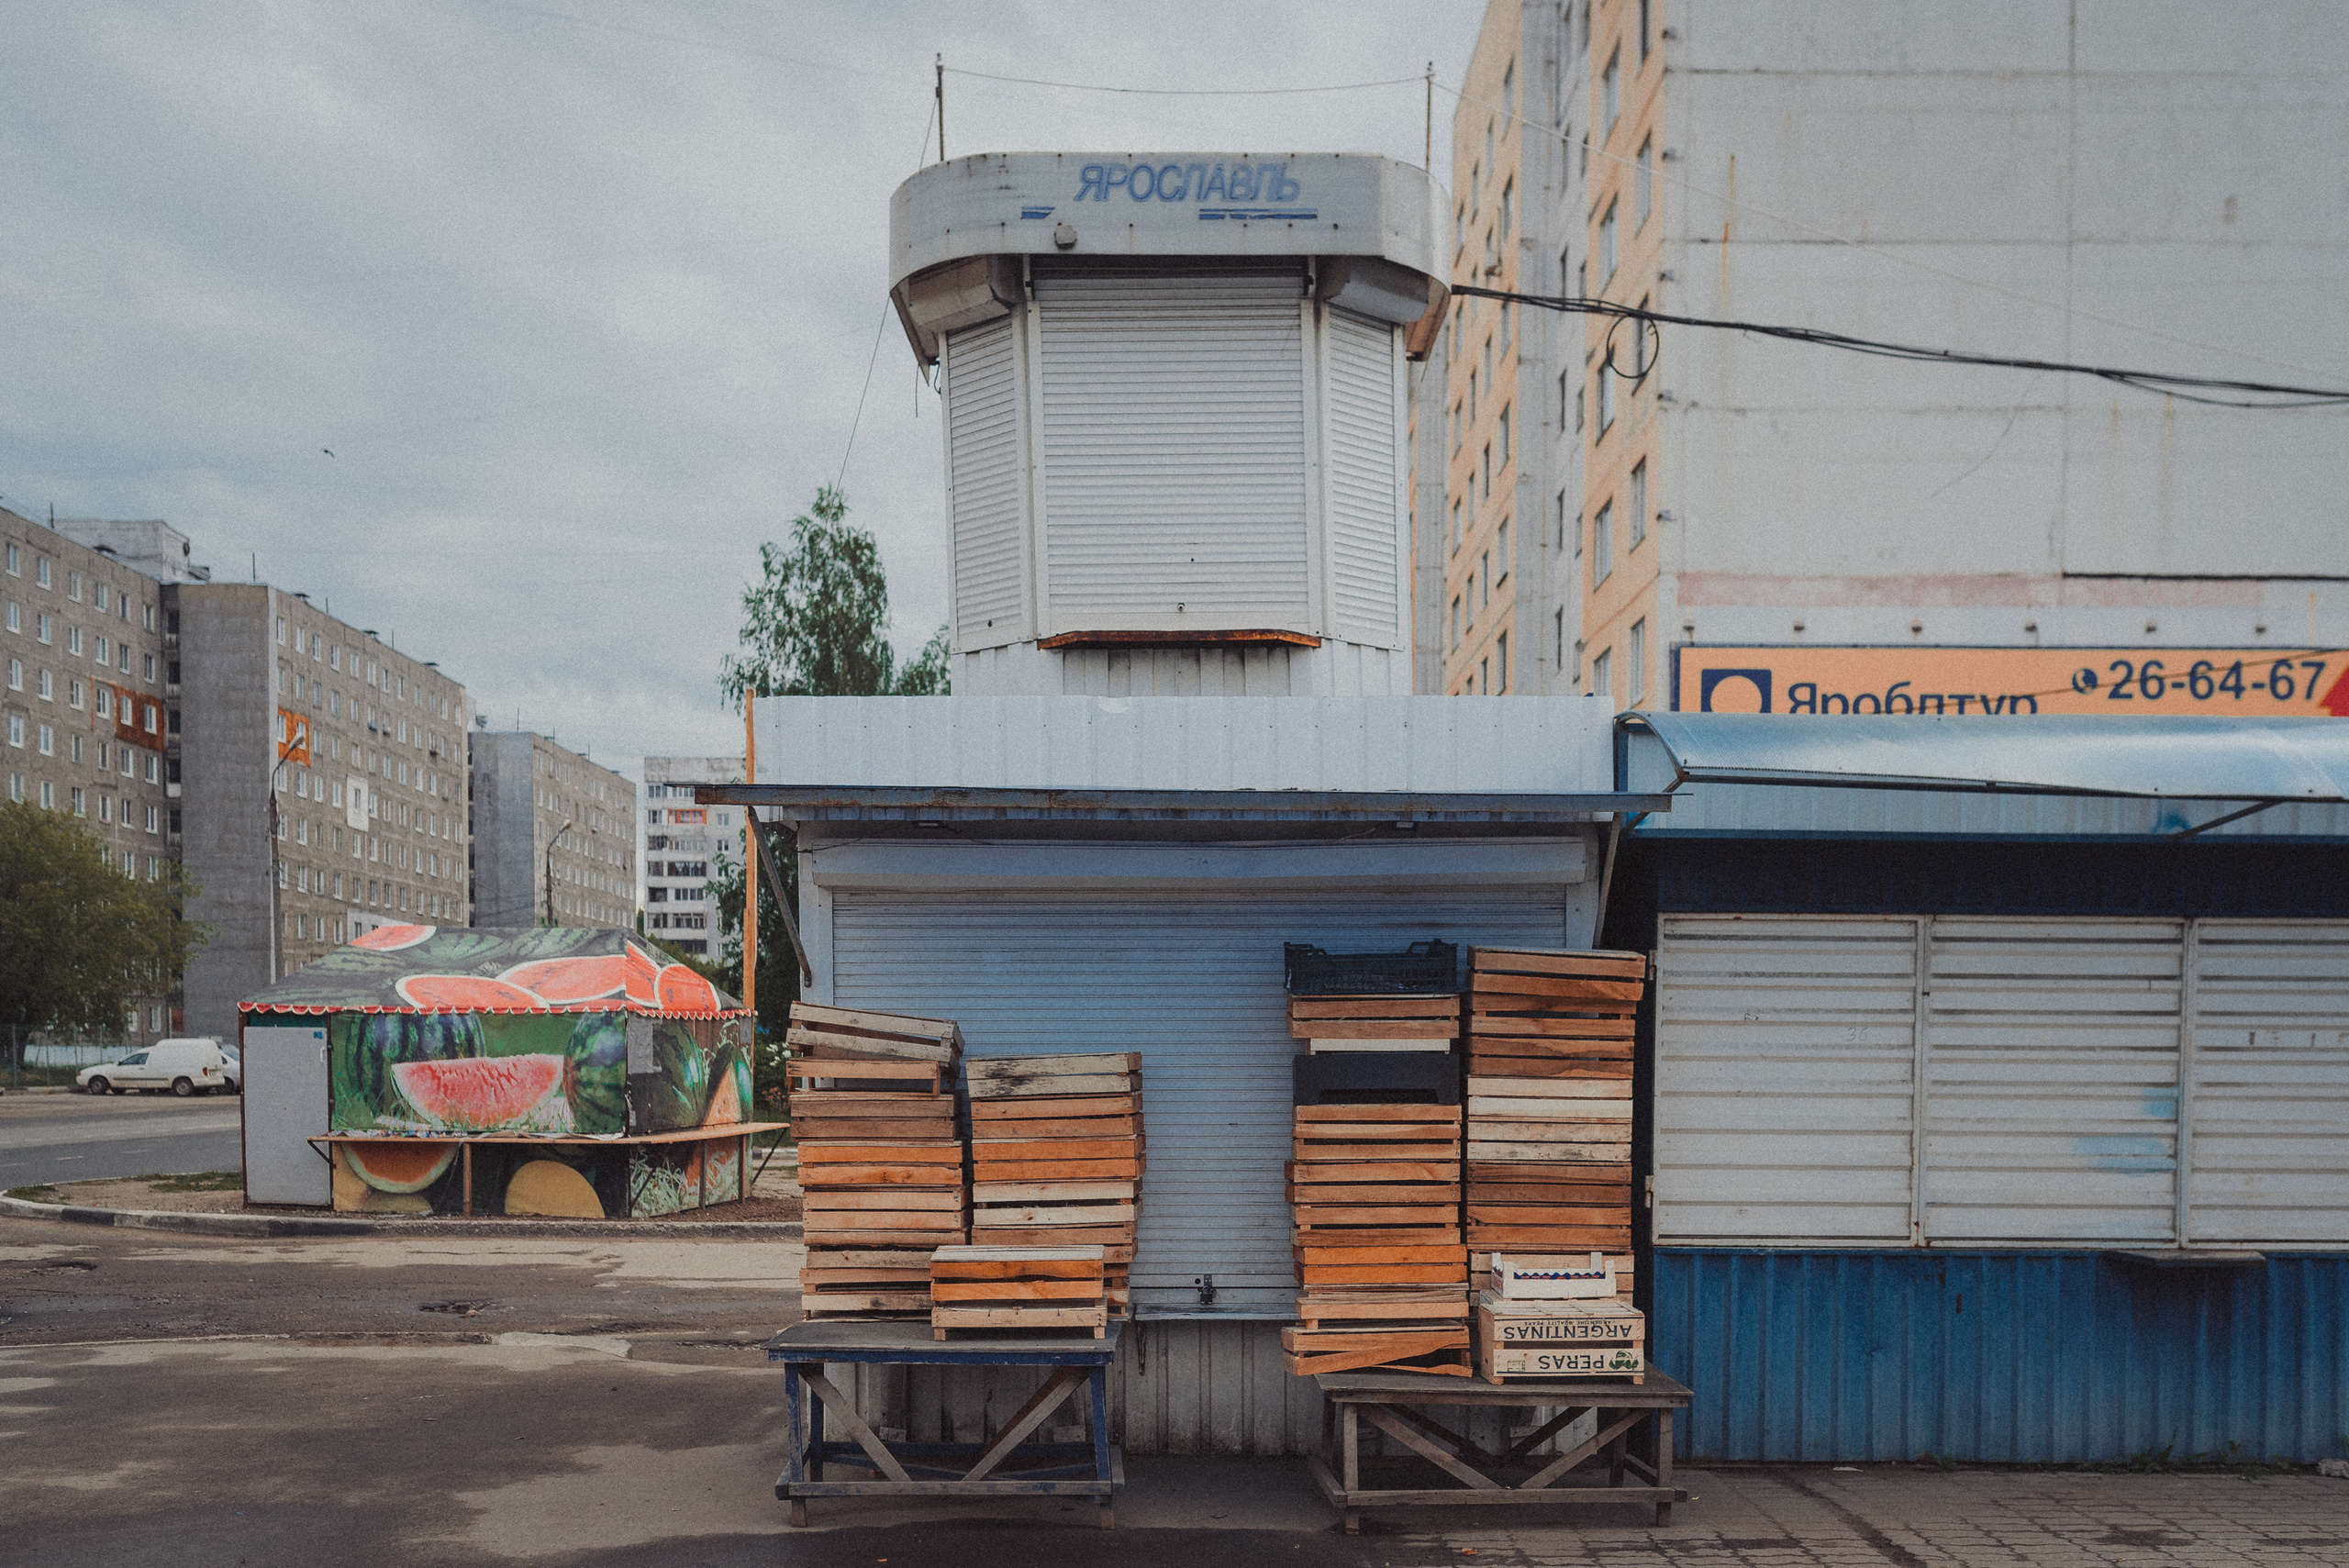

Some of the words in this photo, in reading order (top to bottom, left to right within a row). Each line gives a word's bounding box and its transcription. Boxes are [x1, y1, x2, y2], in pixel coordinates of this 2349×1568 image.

[1074, 162, 1301, 203] ЯРОСЛАВЛЬ
[2108, 659, 2327, 701] 26-64-67
[1503, 1325, 1632, 1340] ARGENTINAS
[1538, 1354, 1605, 1370] PERAS
